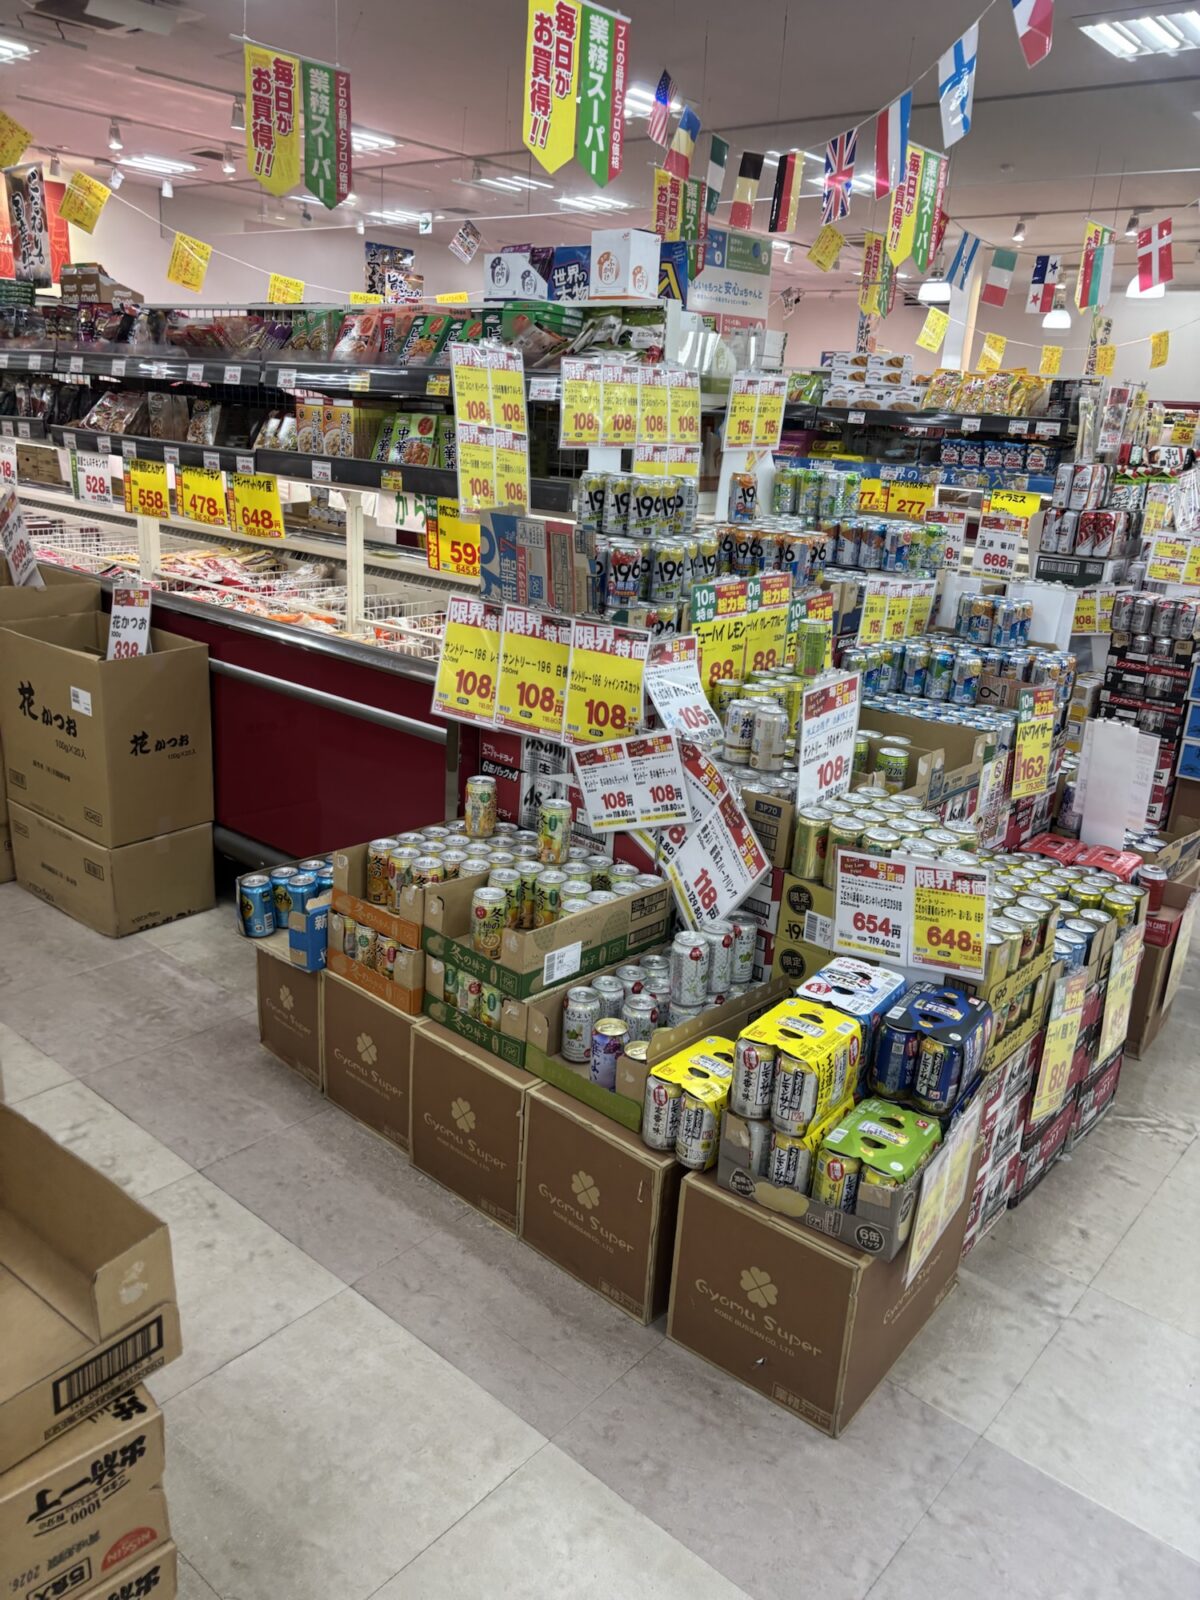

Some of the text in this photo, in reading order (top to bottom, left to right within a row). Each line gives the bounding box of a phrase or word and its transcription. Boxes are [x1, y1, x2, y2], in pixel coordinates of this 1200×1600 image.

[554, 1, 578, 98] 毎日が
[271, 57, 295, 135] 毎日が
[583, 14, 610, 175] 業務スーパー
[308, 67, 331, 199] 業務スーパー
[684, 181, 698, 261] 業務スーパー
[889, 184, 905, 252] 買得!!
[917, 157, 938, 266] 業務スーパー
[993, 491, 1027, 504] ティラミス
[450, 540, 480, 566] 59
[695, 589, 716, 606] 10月
[747, 582, 761, 596] 0月
[111, 614, 148, 631] 花かつお
[506, 609, 573, 646] 限界特価
[727, 620, 747, 641] レモン
[575, 625, 649, 660] 限界特価
[17, 680, 78, 738] 花かつお
[517, 681, 564, 717] 108円
[130, 730, 190, 757] 花かつお
[537, 763, 552, 776] 生
[758, 804, 778, 817] 3P70
[372, 856, 385, 877] 冬の
[915, 868, 987, 896] 限界特価
[916, 897, 945, 906] サントリー
[852, 911, 902, 939] 654円
[926, 925, 983, 956] 648円
[423, 1111, 507, 1170] Gyomu Super
[538, 1183, 585, 1222] Gyomu
[589, 1209, 634, 1254] Super
[858, 1226, 882, 1244] 6缶
[694, 1278, 822, 1357] Gyomu Super
[26, 1434, 147, 1525] 出前一丁
[70, 1498, 102, 1525] 1000
[105, 1529, 152, 1564] NISSIN
